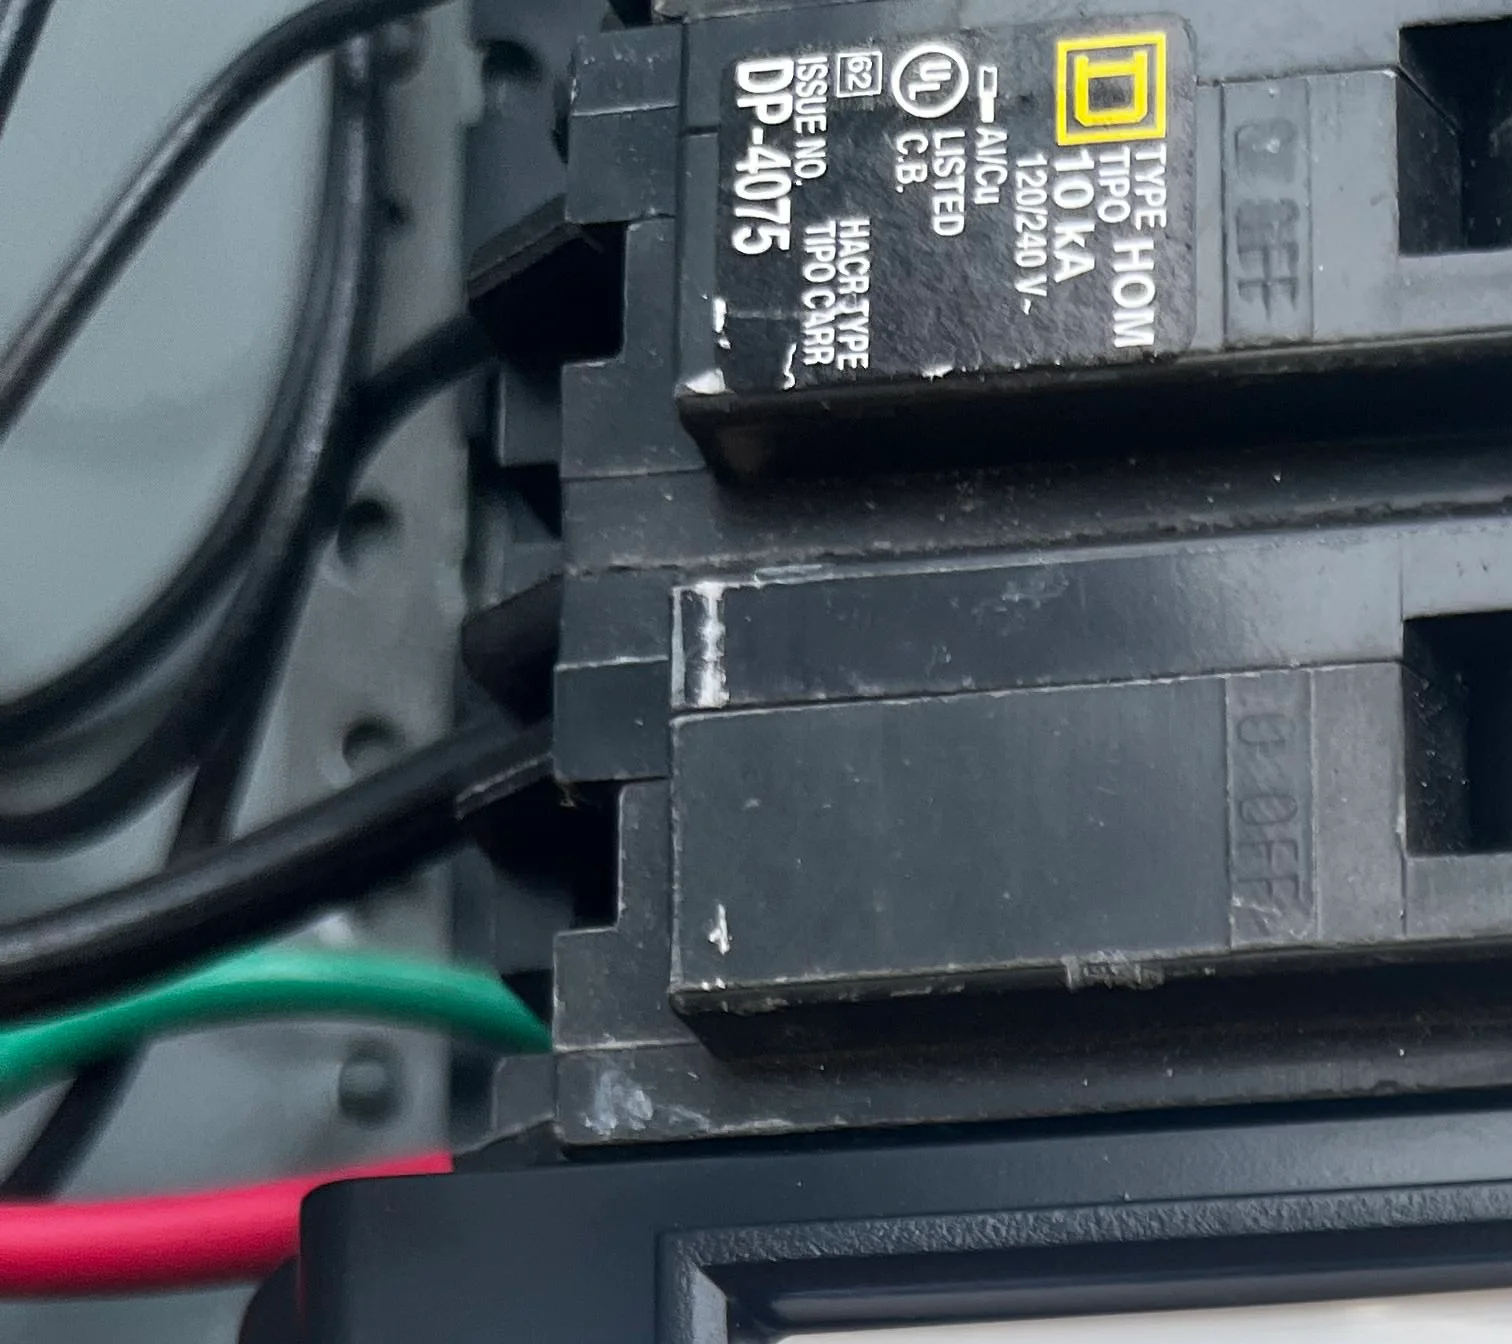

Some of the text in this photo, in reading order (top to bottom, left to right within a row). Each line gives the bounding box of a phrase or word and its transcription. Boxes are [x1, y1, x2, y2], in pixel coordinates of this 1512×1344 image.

[794, 57, 828, 186] ISSUE NO.
[847, 56, 872, 91] 62
[731, 59, 795, 255] DP-4075
[895, 131, 929, 193] C.B.
[931, 129, 966, 237] LISTED
[974, 127, 1008, 205] Al/Cu
[1014, 153, 1048, 268] 120/240
[1097, 146, 1131, 223] TIPO
[1053, 148, 1096, 283] 10 kA
[1112, 144, 1167, 348] TYPE HOM
[803, 219, 836, 366] TIPO CARR
[837, 218, 871, 370] HACR TYPE
[1238, 794, 1300, 901] OFF
